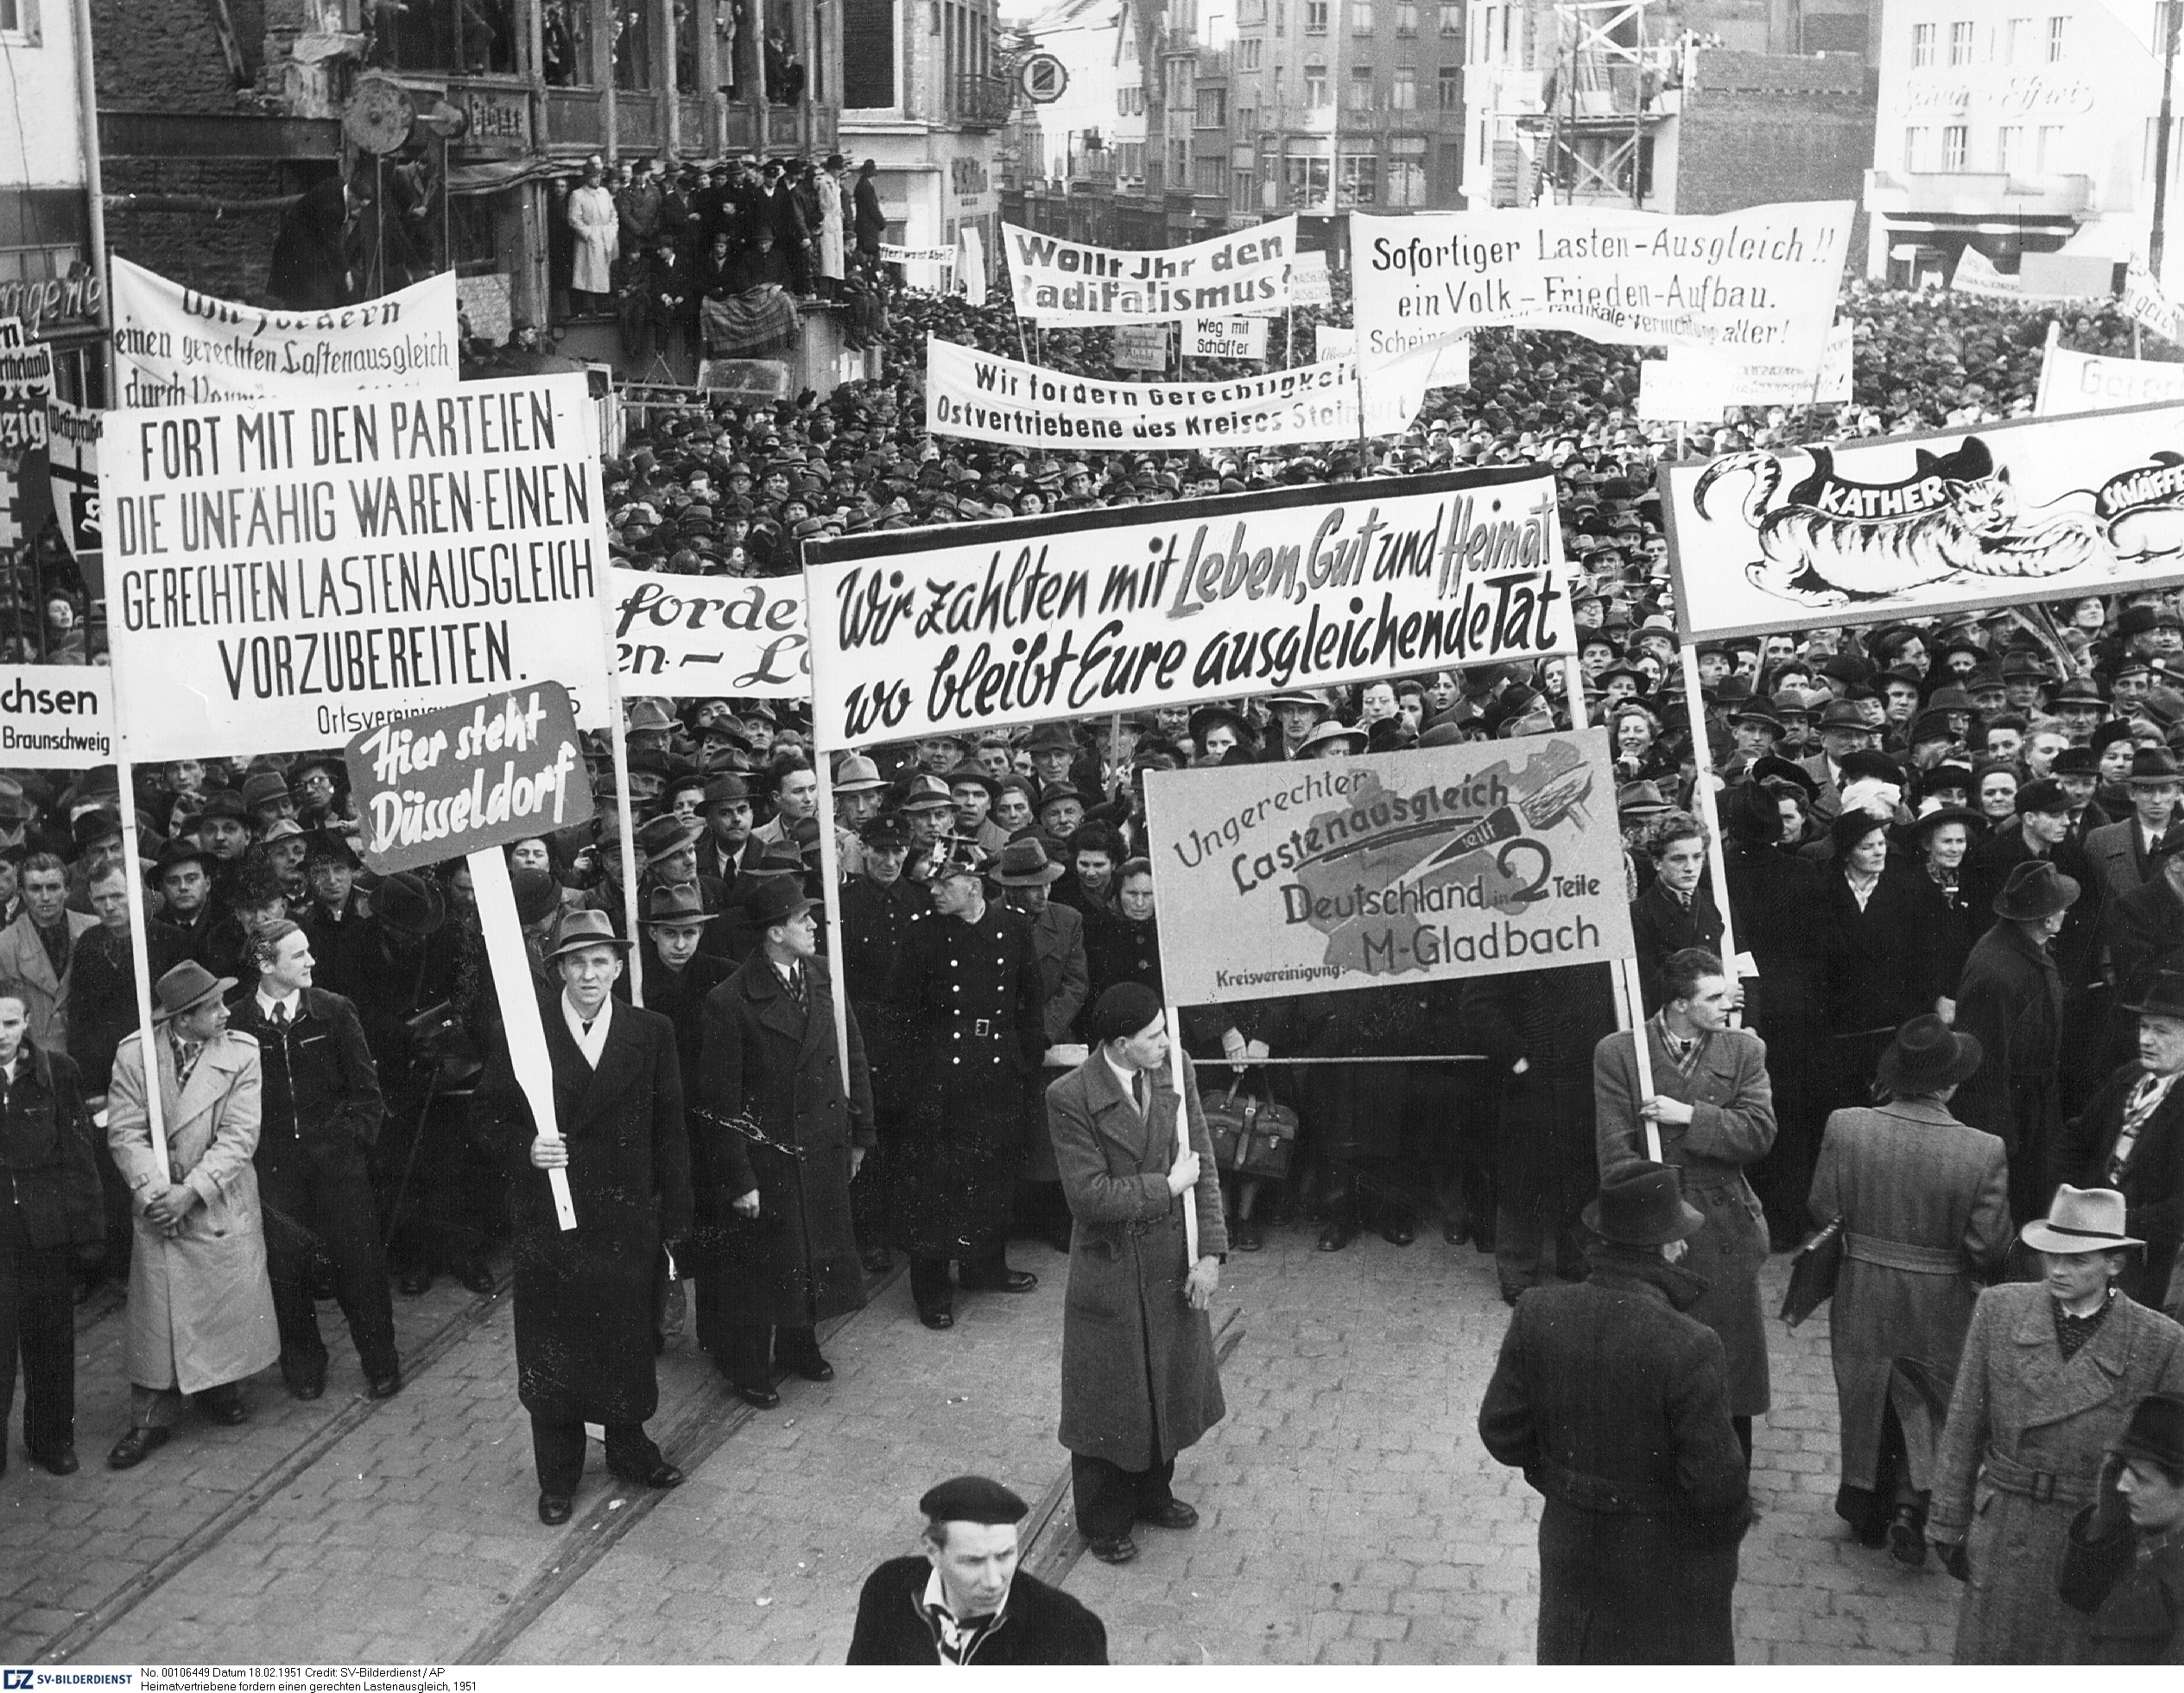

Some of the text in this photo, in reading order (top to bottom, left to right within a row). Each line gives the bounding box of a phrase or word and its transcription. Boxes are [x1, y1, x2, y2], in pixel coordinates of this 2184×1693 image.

[1211, 234, 1283, 272] den
[1371, 234, 1521, 277] Sofortiger
[1398, 284, 1440, 318] ein
[1445, 278, 1511, 314] Volk
[115, 317, 171, 359] einen
[182, 335, 276, 373] gerechten
[1197, 318, 1250, 338] Weg mit
[1197, 338, 1250, 357] Schäffer
[974, 361, 1018, 395] Wir
[1029, 373, 1138, 407] fordern
[141, 414, 221, 482] FORT
[235, 409, 295, 473] MIT
[311, 403, 380, 466] DEN
[936, 395, 1124, 439] Ostvertriebene
[1131, 414, 1176, 439] des
[117, 493, 167, 557] DIE
[180, 480, 337, 553] UNFÄHIG
[1817, 475, 1947, 521] KATHER
[122, 538, 595, 632] GERECHTEN LASTENAUSGLEICH
[835, 491, 1556, 652] Wir zahlten mit Leben, Gut und Heimat
[616, 582, 804, 638] forde
[217, 619, 528, 700] VORZUBEREITEN.
[842, 570, 1561, 740] wo bleibt Eure ausgleichende Tat
[3, 727, 111, 756] Braunschweig
[359, 724, 448, 785] Hier
[455, 692, 547, 761] steht
[369, 741, 577, 854] Düsseldorf
[1173, 769, 1369, 869] Ungerechter
[1231, 774, 1510, 896] Lastenausgleich
[1283, 875, 1487, 925] Deutschland
[1497, 837, 1552, 903] 2
[1552, 874, 1600, 899] Teile
[1361, 913, 1600, 972] M-Gladbach
[1216, 962, 1348, 989] Kreisvereinigung:
